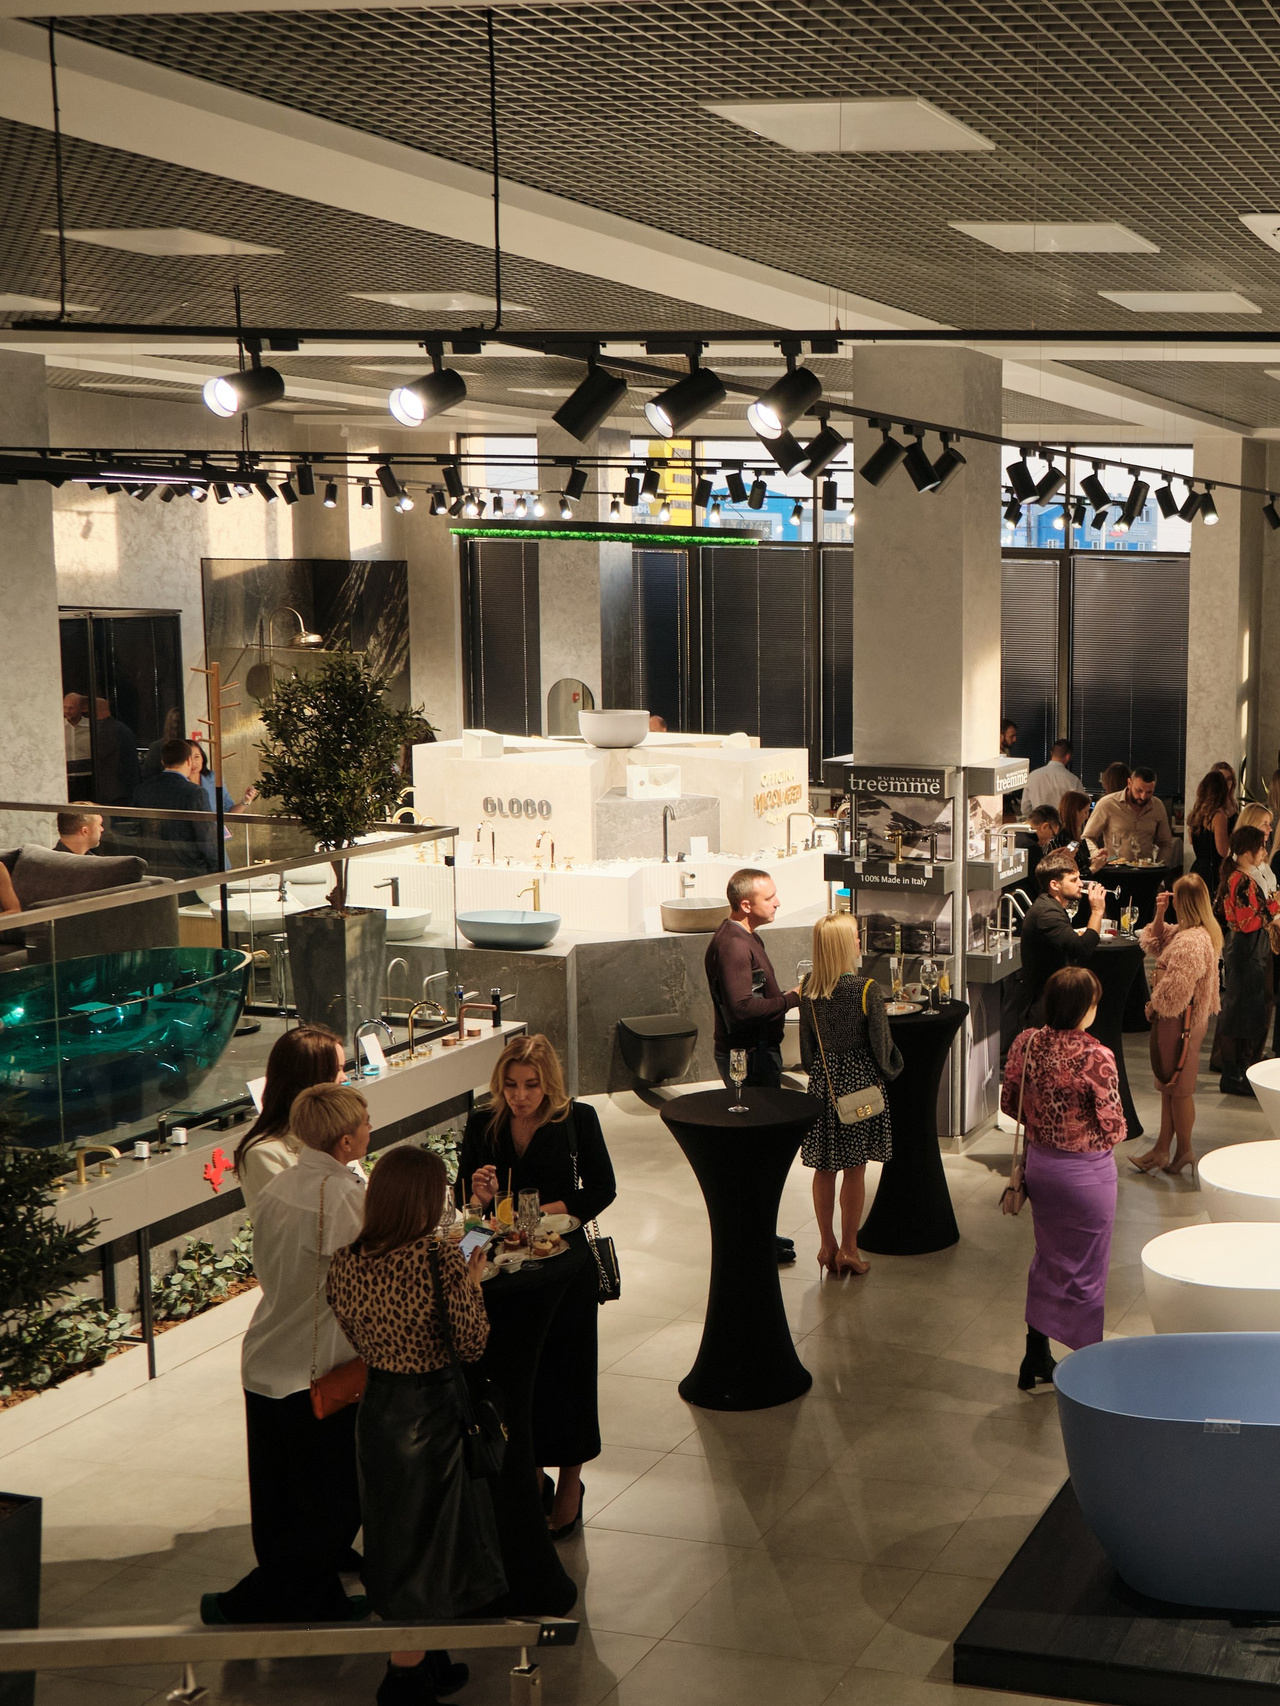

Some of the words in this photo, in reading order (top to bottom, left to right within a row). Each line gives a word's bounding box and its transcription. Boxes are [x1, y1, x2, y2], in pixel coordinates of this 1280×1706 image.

[848, 773, 941, 795] treemme
[996, 772, 1028, 792] treemme
[482, 796, 552, 818] GLOBO
[860, 874, 880, 883] 100%
[881, 875, 901, 884] Made
[902, 876, 910, 885] in
[911, 877, 927, 887] Italy
